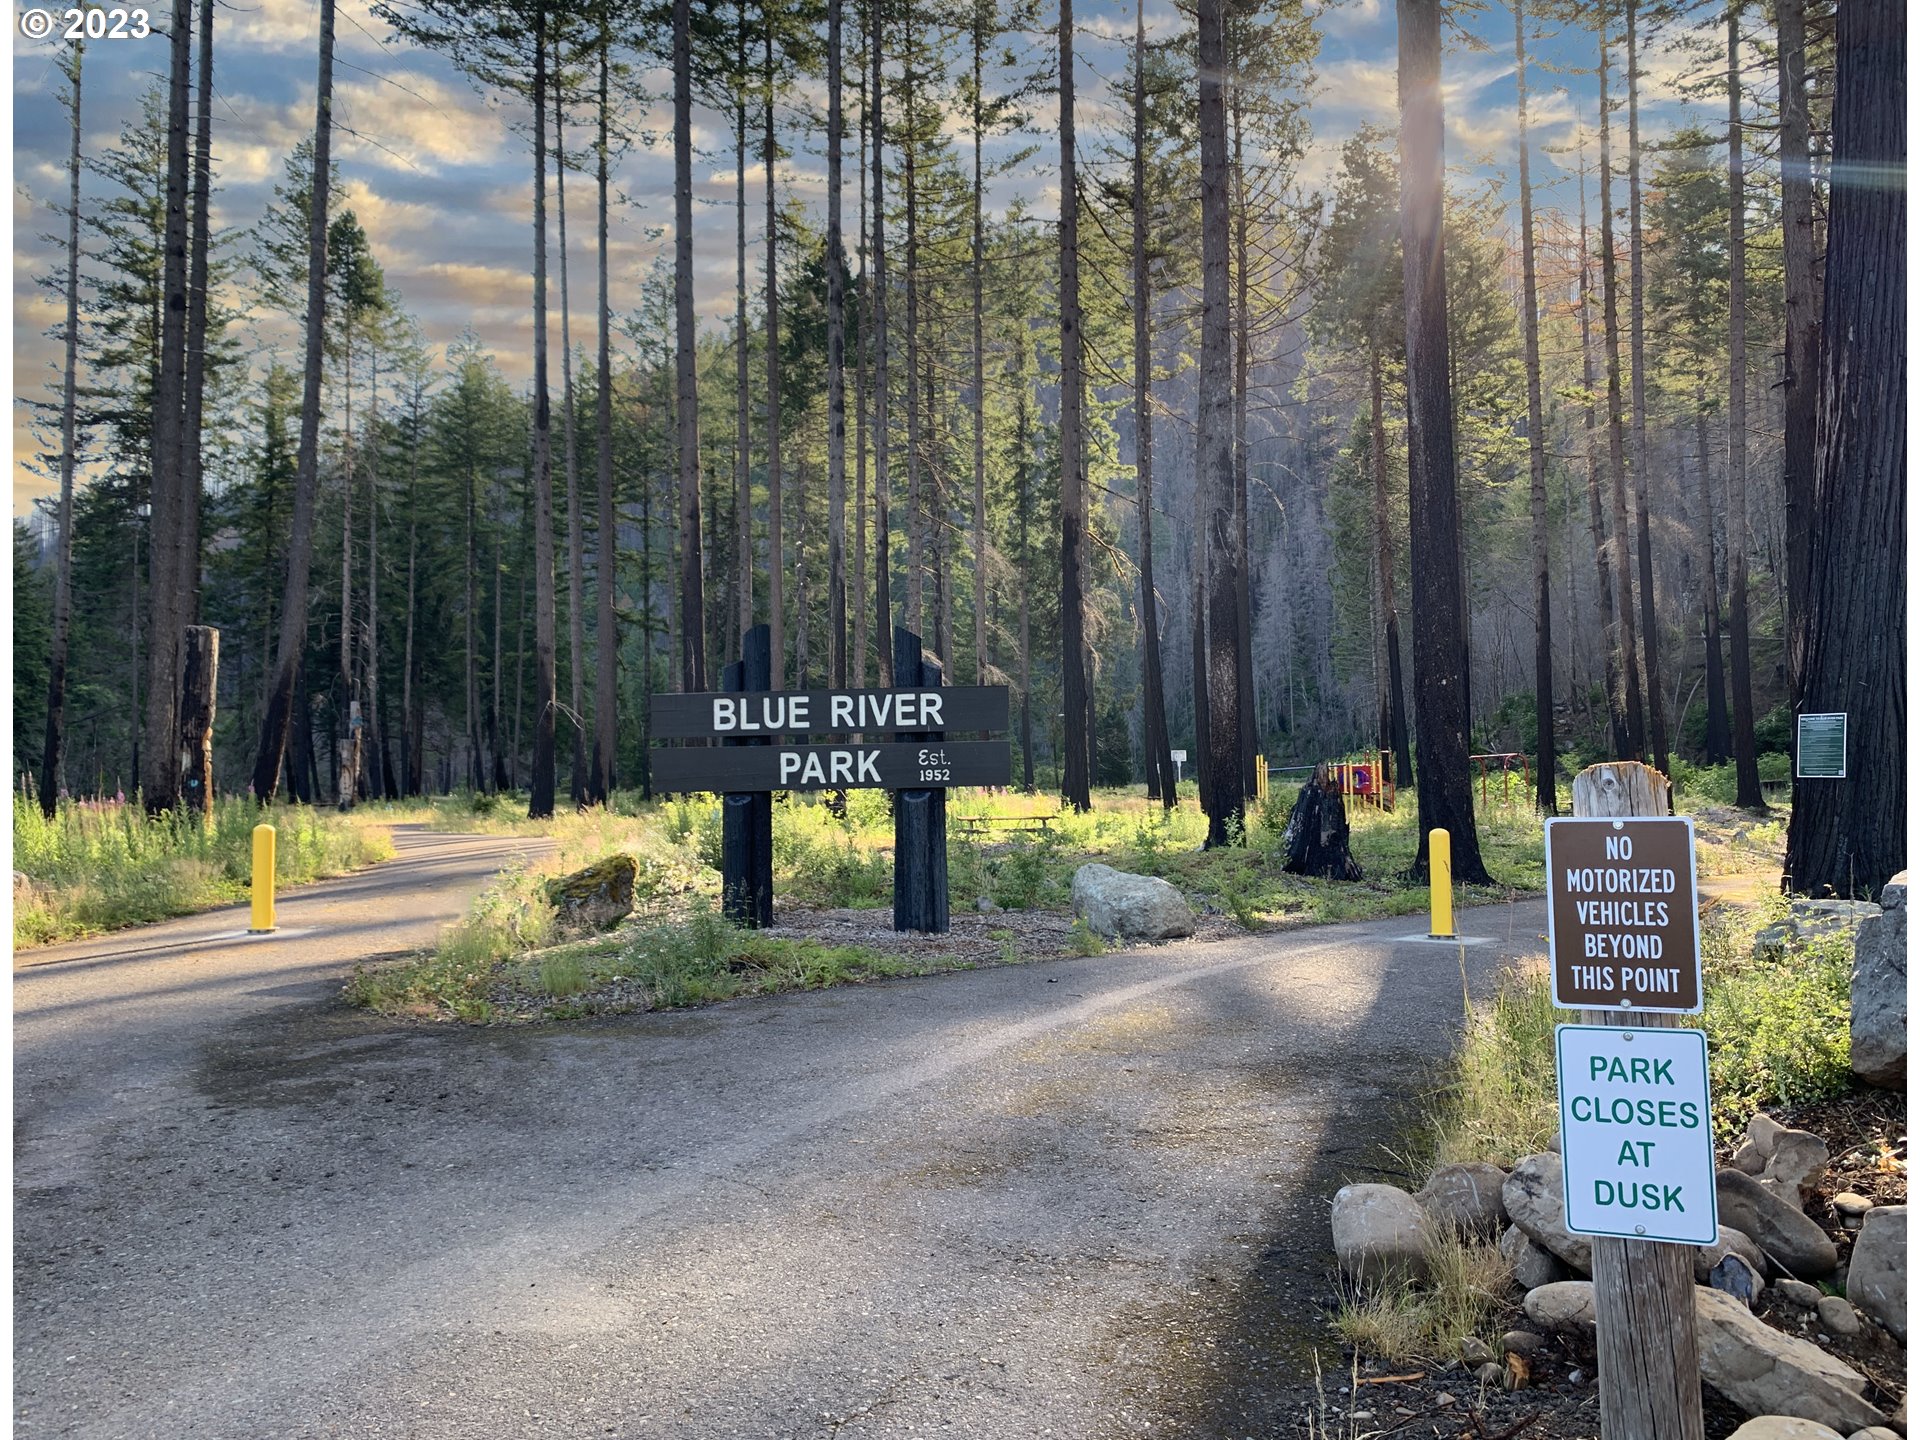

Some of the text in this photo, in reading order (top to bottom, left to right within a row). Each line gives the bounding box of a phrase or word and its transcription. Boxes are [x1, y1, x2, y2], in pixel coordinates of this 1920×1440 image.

[713, 693, 944, 731] BLUE RIVER
[779, 750, 882, 784] PARK
[918, 749, 951, 766] Est.
[920, 769, 951, 781] 1952
[1605, 836, 1632, 860] NO
[1566, 868, 1676, 893] MOTORIZED
[1576, 901, 1669, 927] VEHICLES
[1584, 933, 1663, 959] BEYOND
[1571, 965, 1680, 993] THIS POINT
[1589, 1055, 1675, 1085] PARK
[1571, 1095, 1700, 1129] CLOSES
[1617, 1139, 1656, 1168] AT
[1594, 1179, 1685, 1213] DUSK
